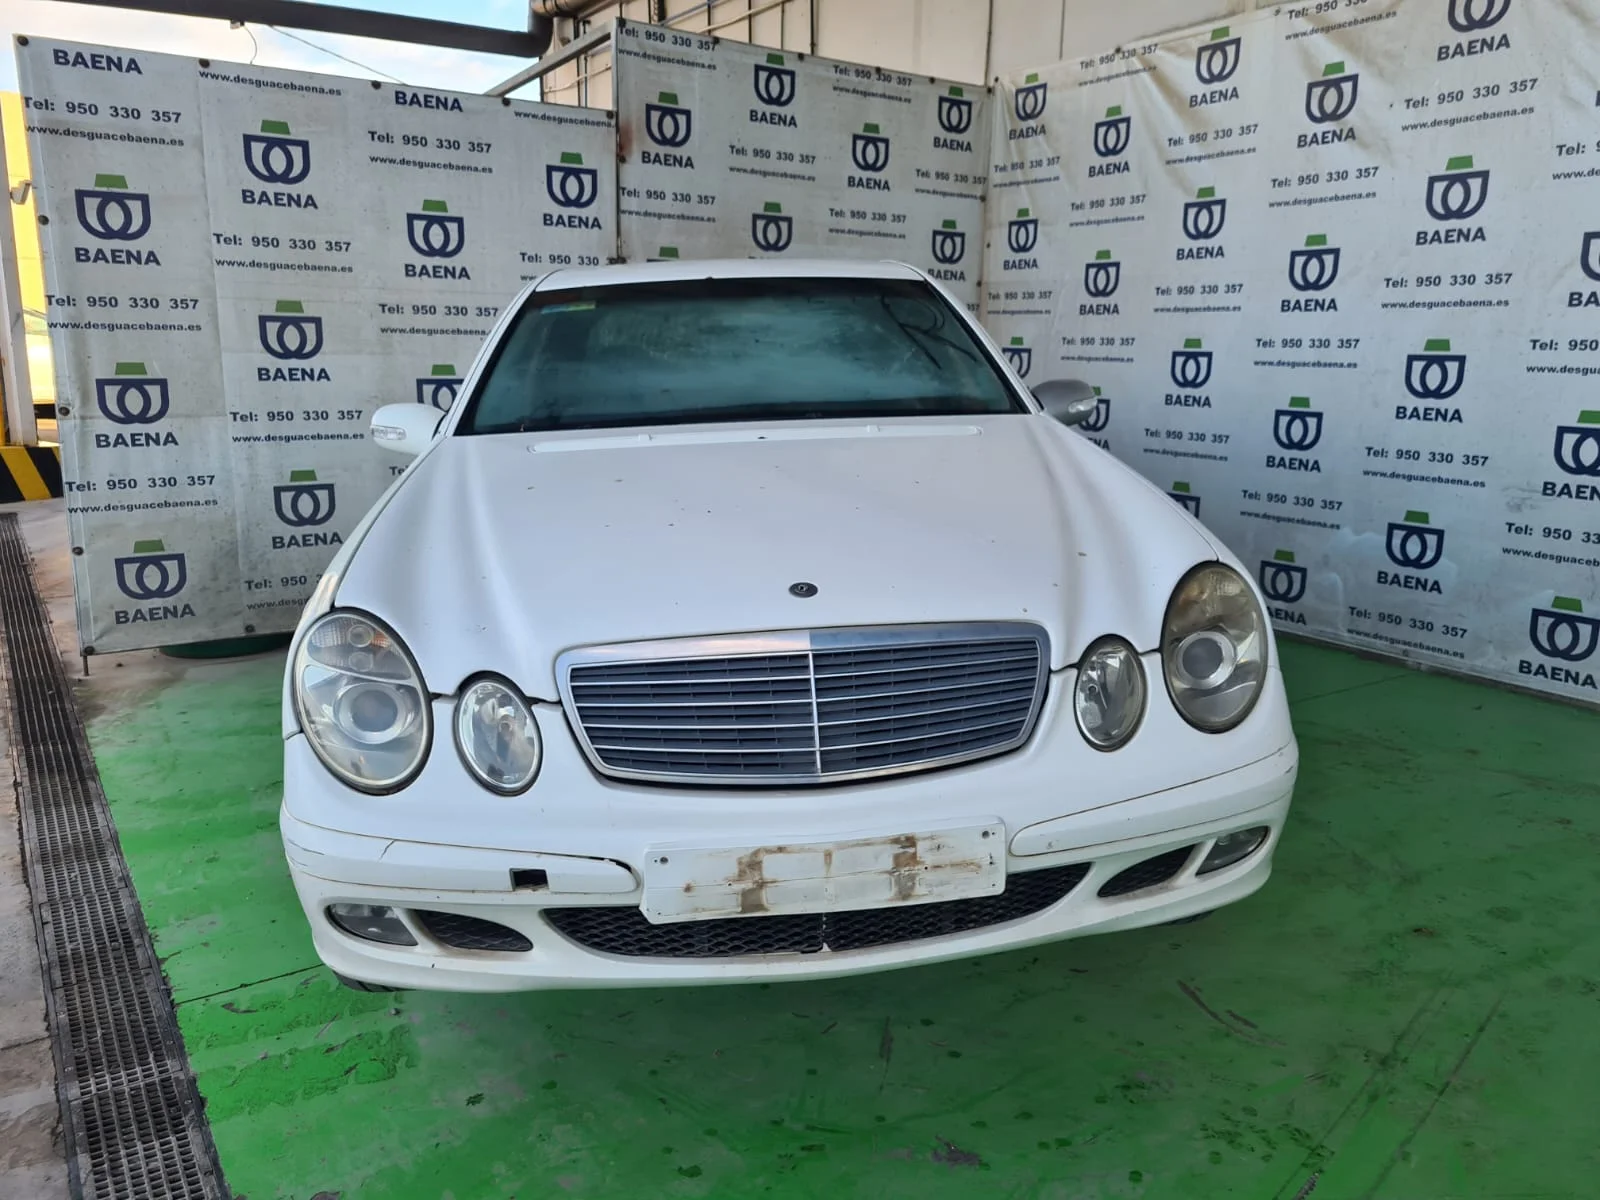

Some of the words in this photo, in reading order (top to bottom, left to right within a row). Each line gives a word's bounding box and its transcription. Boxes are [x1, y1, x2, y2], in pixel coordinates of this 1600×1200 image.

[1287, 7, 1309, 20] Tel:
[1285, 10, 1397, 40] www.desguacebaena.es
[645, 30, 666, 43] 950
[672, 35, 692, 47] 330
[1437, 33, 1511, 62] BAENA
[53, 48, 143, 75] BAENA
[198, 70, 342, 96] www.desguacebaena.es
[394, 90, 464, 113] BAENA
[1189, 86, 1239, 108] BAENA
[1404, 96, 1429, 110] Tel:
[1437, 89, 1464, 105] 950
[1472, 84, 1500, 99] 330
[1509, 77, 1538, 94] 357
[23, 96, 55, 111] Tel:
[65, 101, 99, 116] 950
[109, 105, 141, 120] 330
[151, 110, 182, 123] 357
[749, 109, 798, 128] BAENA
[514, 110, 617, 128] www.desguacebaena.
[1401, 106, 1534, 132] www.desguacebaena.es
[25, 125, 184, 147] www.desguacebaena.es
[1009, 124, 1047, 140] BAENA
[1168, 136, 1184, 147] Tel:
[1189, 132, 1208, 144] 950
[1213, 128, 1233, 140] 330
[1238, 123, 1258, 136] 357
[1297, 127, 1357, 149] BAENA
[368, 130, 394, 144] Tel:
[402, 134, 428, 147] 950
[436, 138, 461, 151] 330
[468, 141, 492, 154] 357
[933, 136, 972, 153] BAENA
[1556, 142, 1586, 157] Tel:
[641, 150, 695, 170] BAENA
[729, 144, 748, 156] Tel:
[752, 148, 771, 159] 950
[776, 151, 794, 162] 330
[799, 153, 816, 165] 357
[369, 156, 493, 174] www.desguacebaena.es
[1088, 160, 1130, 178] BAENA
[847, 175, 891, 192] BAENA
[1271, 177, 1291, 188] Tel:
[1297, 173, 1319, 186] 950
[1326, 170, 1349, 183] 330
[1355, 166, 1379, 179] 357
[241, 188, 319, 210] BAENA
[620, 187, 640, 198] Tel:
[645, 189, 666, 200] 950
[672, 192, 691, 203] 330
[697, 194, 716, 205] 357
[1269, 192, 1376, 208] www.desguacebaena.es
[543, 213, 602, 230] BAENA
[212, 233, 242, 246] Tel:
[251, 235, 280, 248] 950
[289, 238, 316, 250] 330
[325, 240, 351, 252] 357
[1415, 226, 1486, 246] BAENA
[74, 247, 161, 266] BAENA
[519, 252, 542, 263] Tel:
[549, 254, 571, 265] 950
[578, 255, 599, 266] 330
[1176, 245, 1225, 261] BAENA
[215, 259, 353, 273] www.desguacebaena.es
[404, 263, 471, 280] BAENA
[1003, 258, 1039, 271] BAENA
[1384, 277, 1408, 288] Tel:
[1416, 275, 1442, 287] 950
[1449, 274, 1476, 286] 330
[1484, 272, 1513, 285] 357
[1155, 286, 1172, 296] Tel:
[1177, 285, 1195, 295] 950
[1200, 284, 1219, 295] 330
[1224, 283, 1244, 294] 357
[44, 294, 77, 307] Tel:
[86, 296, 119, 308] 950
[128, 297, 160, 309] 330
[169, 298, 199, 310] 357
[378, 303, 404, 314] Tel:
[412, 304, 437, 315] 950
[444, 305, 468, 317] 330
[475, 306, 499, 317] 357
[1079, 303, 1120, 316] BAENA
[1280, 298, 1338, 313] BAENA
[1381, 299, 1510, 310] www.desguacebaena.es
[47, 321, 202, 332] www.desguacebaena.es
[380, 326, 491, 336] www.desguacebaena.
[1256, 338, 1275, 348] Tel:
[1281, 338, 1303, 349] 950
[1308, 338, 1331, 349] 330
[1337, 338, 1360, 349] 357
[1529, 339, 1559, 351] Tel:
[1568, 339, 1599, 351] 950
[1253, 360, 1358, 369] www.desguacebaena.es
[257, 367, 331, 382] BAENA
[1164, 393, 1212, 408] BAENA
[229, 411, 258, 422] Tel:
[267, 411, 294, 422] 950
[302, 410, 329, 421] 330
[337, 409, 363, 420] 357
[1395, 405, 1463, 424] BAENA
[95, 432, 179, 448] BAENA
[232, 432, 364, 443] www.desguacebaena.es
[1144, 428, 1161, 438] Tel:
[1165, 430, 1183, 440] 950
[1188, 432, 1206, 442] 330
[1211, 434, 1230, 444] 357
[1266, 455, 1321, 473] BAENA
[1365, 446, 1389, 458] Tel:
[1396, 448, 1420, 461] 950
[1428, 451, 1454, 464] 330
[1462, 454, 1489, 467] 357
[65, 480, 97, 493] Tel:
[106, 478, 138, 490] 950
[147, 476, 177, 488] 330
[187, 475, 215, 486] 357
[1363, 470, 1486, 488] www.desguacebaena.es
[1241, 489, 1261, 501] Tel:
[1267, 493, 1287, 504] 950
[1293, 496, 1314, 507] 330
[1320, 499, 1343, 511] 357
[1541, 481, 1600, 501] BAEN
[67, 499, 218, 514] www.desguacebaena.es
[1240, 511, 1340, 530] www.desguacebaena.es
[272, 531, 344, 550] BAENA
[1505, 522, 1533, 536] Tel:
[1542, 526, 1572, 541] 950
[1581, 531, 1600, 544] 33
[1502, 547, 1600, 567] www.desguaceb
[244, 579, 272, 591] Tel:
[281, 575, 307, 587] 950
[1377, 570, 1443, 595] BAENA
[115, 603, 196, 625] BAENA
[1348, 606, 1371, 619] Tel:
[1378, 612, 1402, 625] 950
[1409, 618, 1434, 632] 330
[1441, 624, 1467, 638] 357
[1347, 629, 1464, 659] www.desguacebaena.es
[1518, 659, 1598, 690] BAENA
